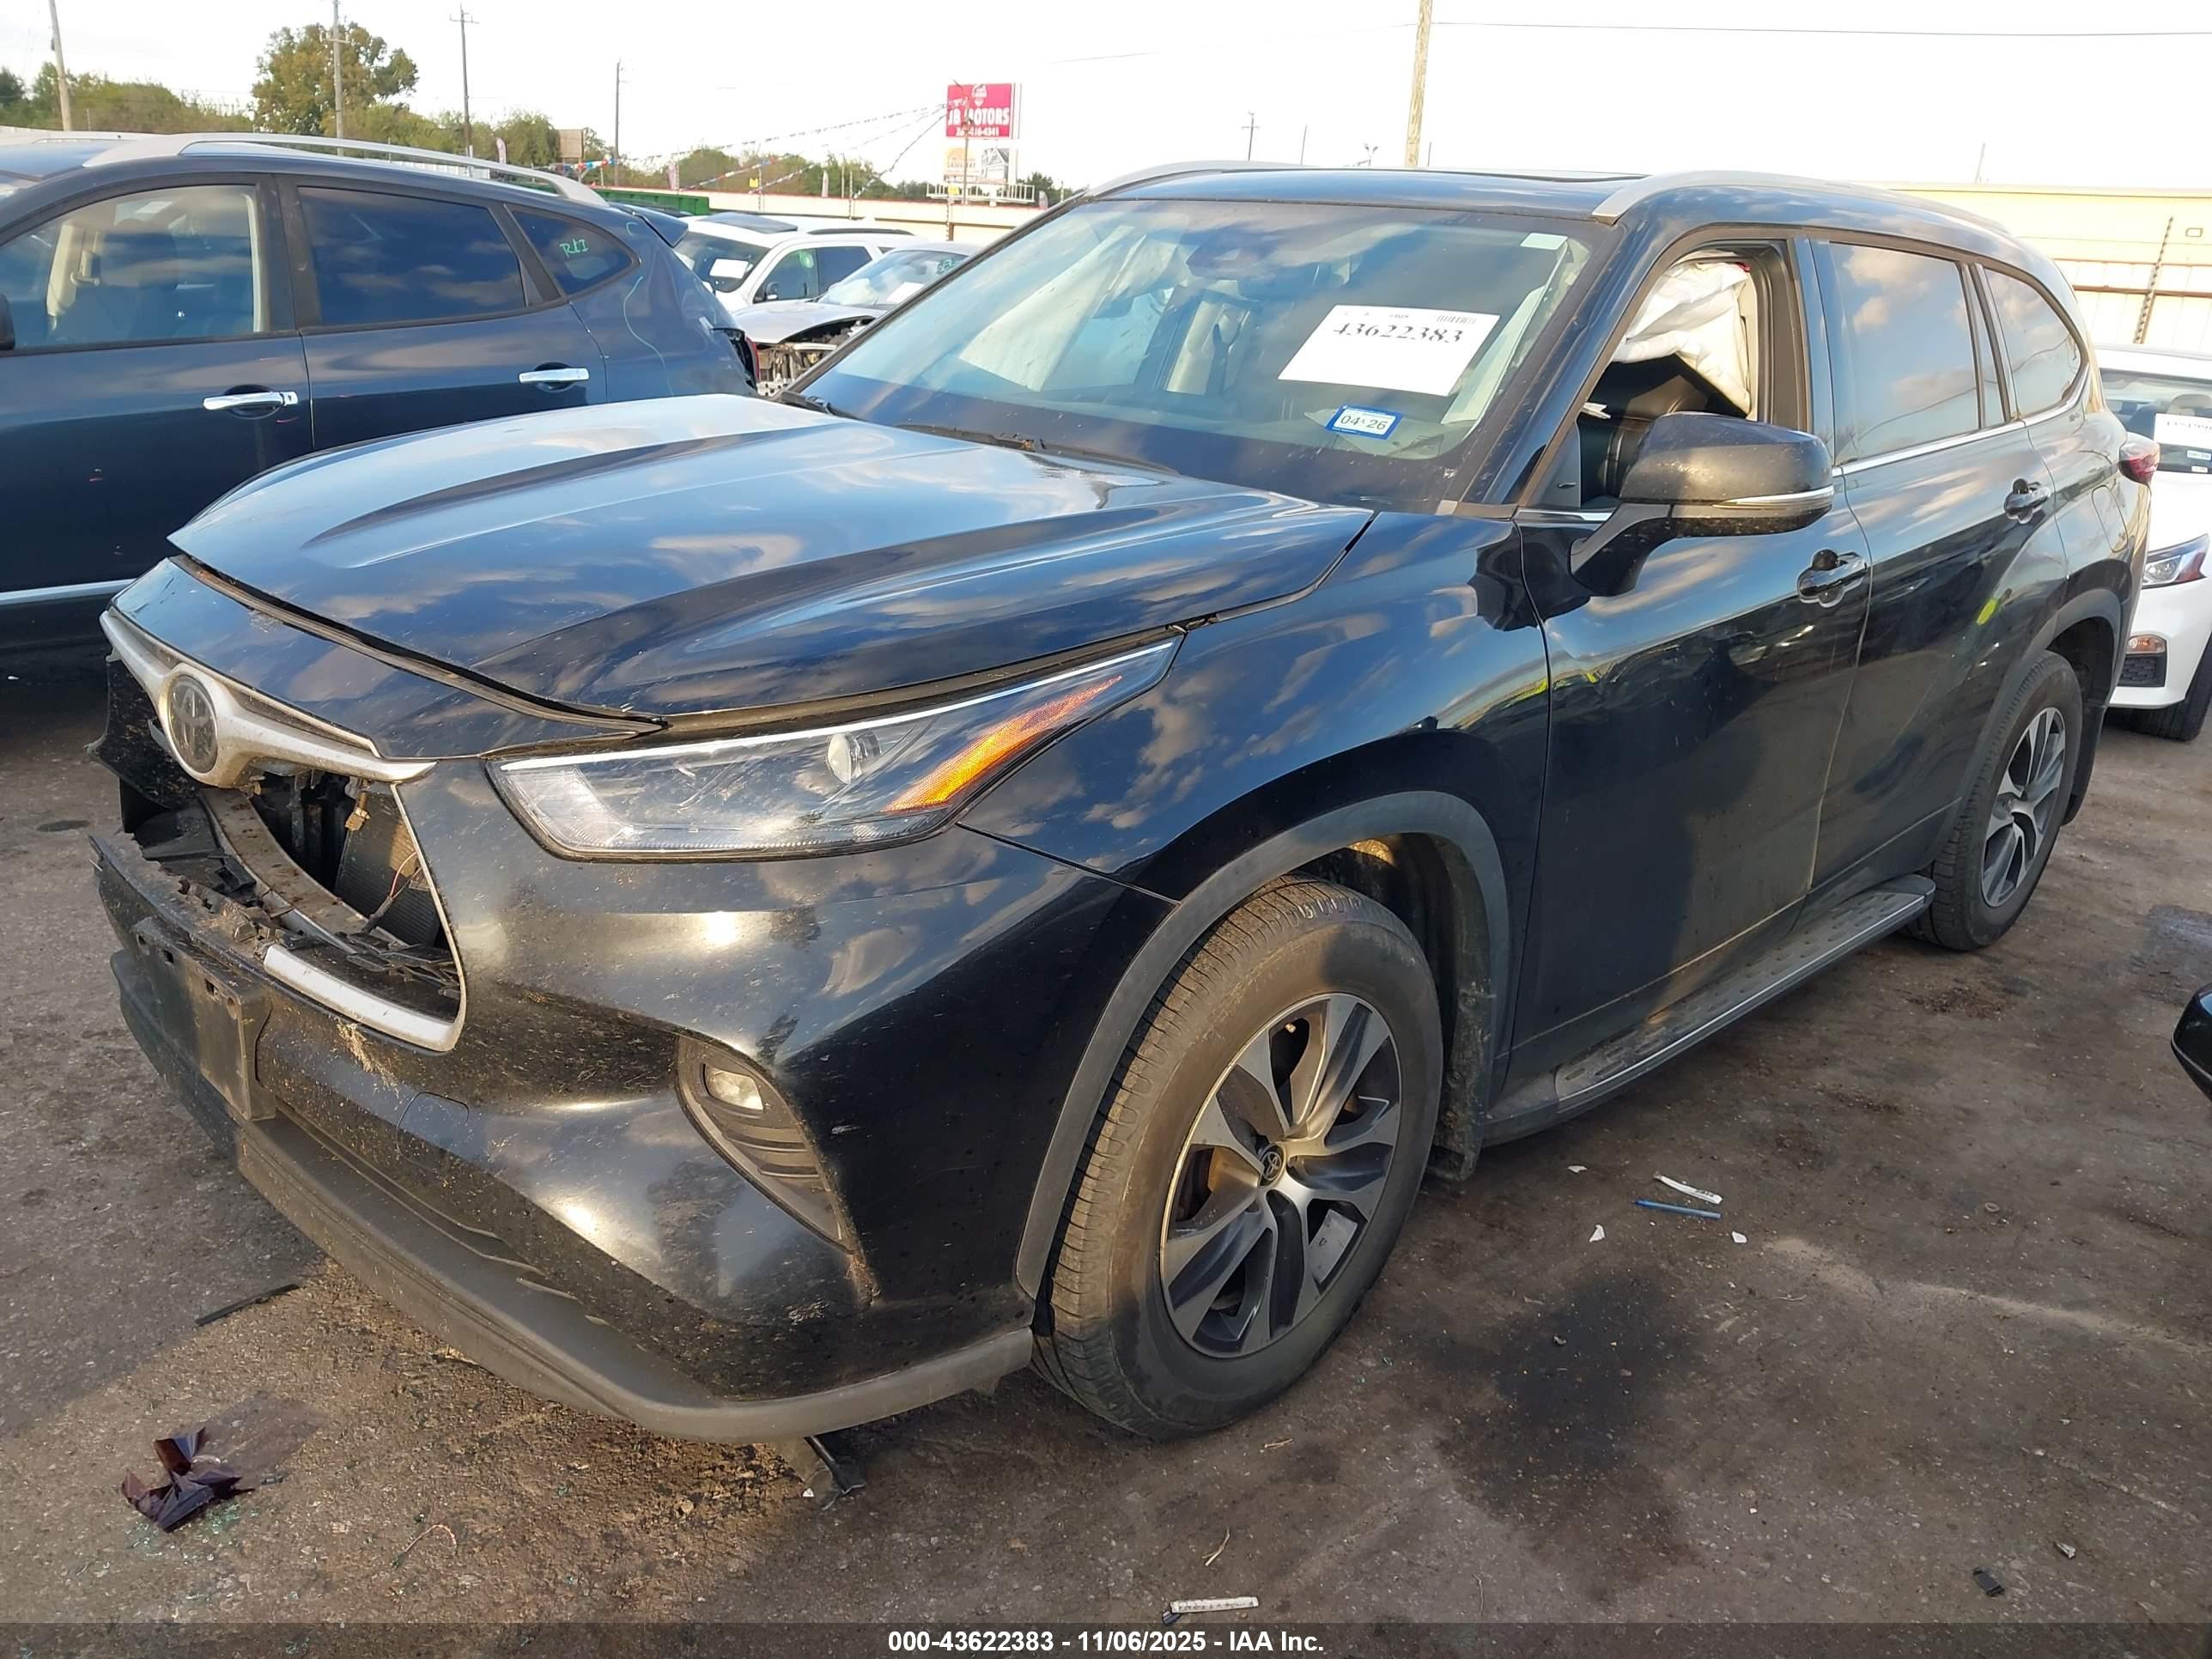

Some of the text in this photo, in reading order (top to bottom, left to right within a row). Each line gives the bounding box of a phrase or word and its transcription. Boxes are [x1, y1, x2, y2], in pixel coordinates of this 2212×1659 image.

[964, 107, 1010, 125] MOTORS
[956, 126, 1000, 137] 2-416-4341
[1333, 323, 1463, 343] 43622383
[1340, 415, 1389, 430] 04 26
